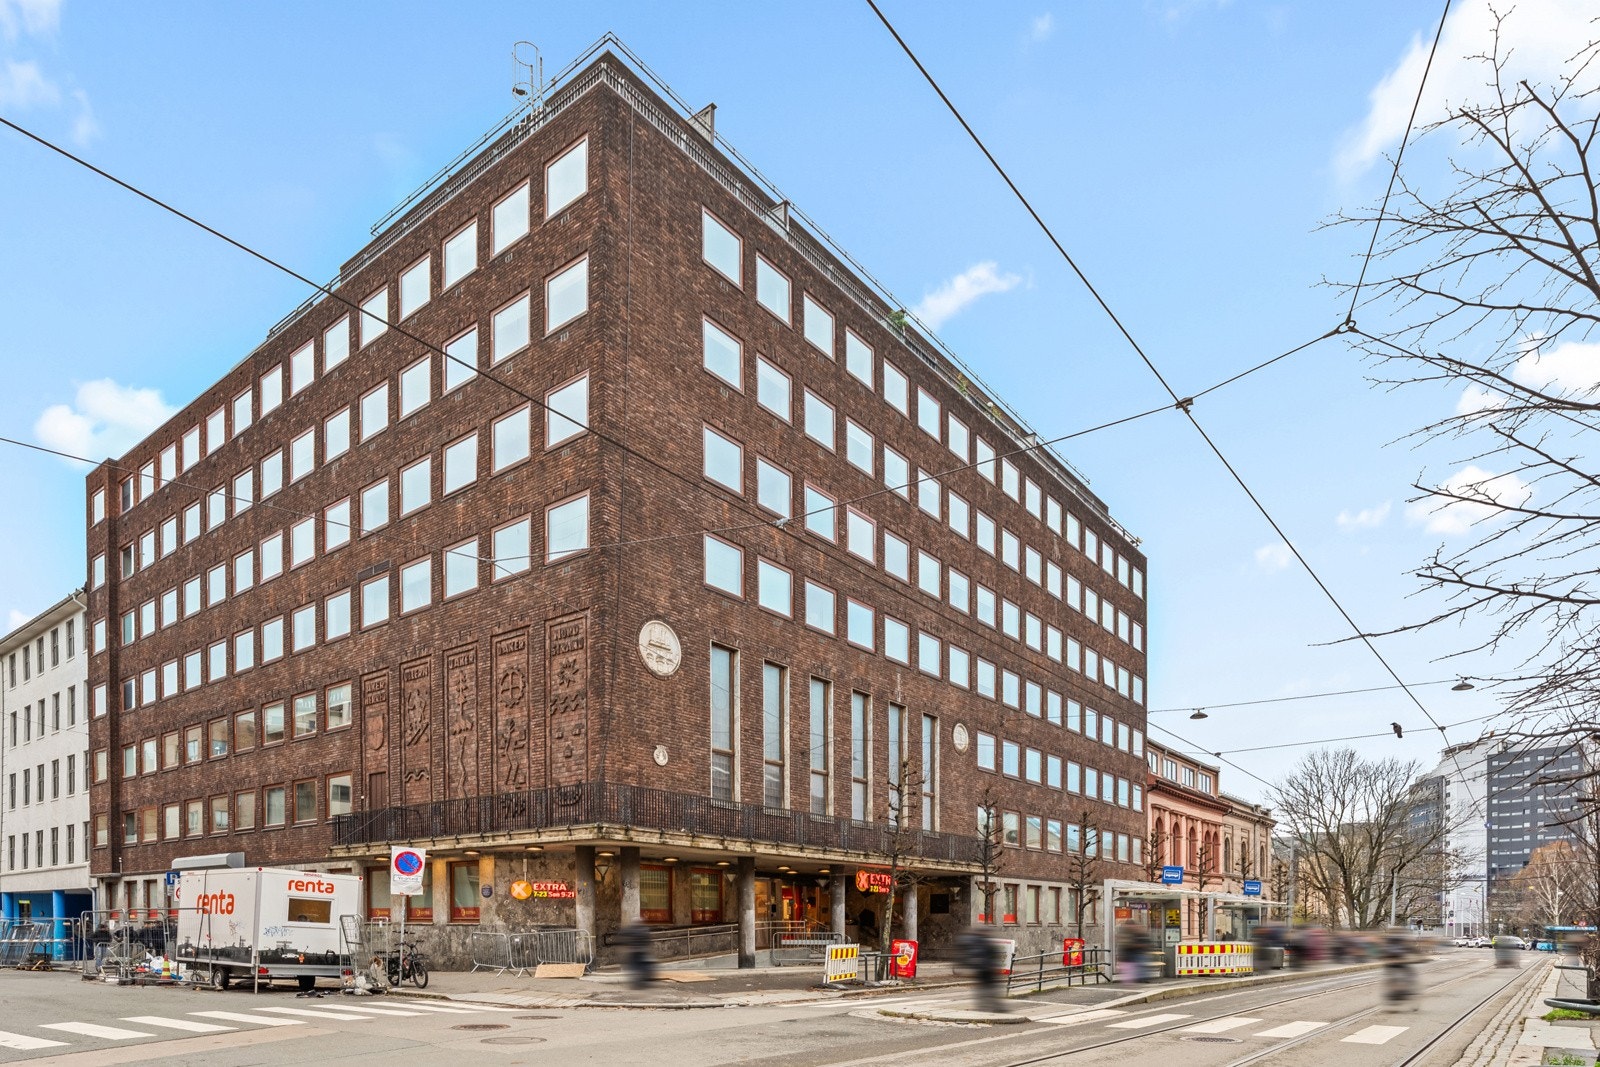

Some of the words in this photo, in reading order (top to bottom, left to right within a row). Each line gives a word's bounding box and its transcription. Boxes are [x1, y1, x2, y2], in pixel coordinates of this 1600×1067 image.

[287, 879, 335, 894] renta
[533, 883, 567, 891] EXTRA
[196, 889, 235, 915] renta
